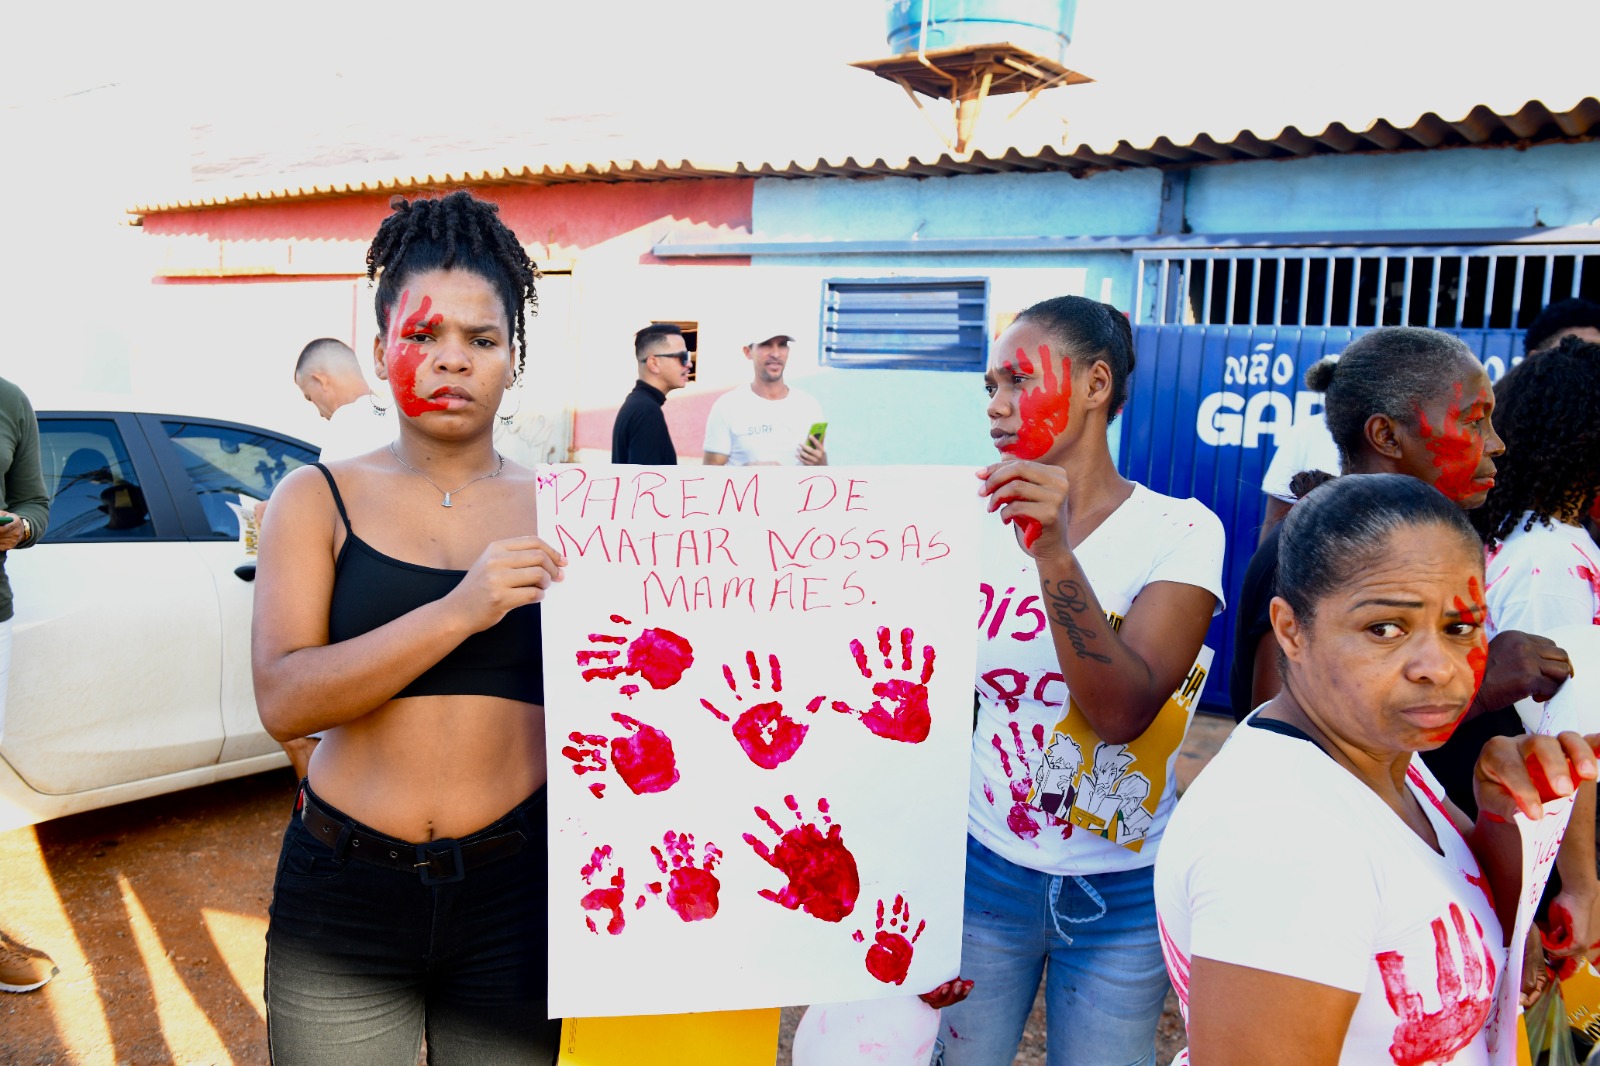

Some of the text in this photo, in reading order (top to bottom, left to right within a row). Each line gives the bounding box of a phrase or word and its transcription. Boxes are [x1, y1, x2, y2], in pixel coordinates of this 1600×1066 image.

[1223, 343, 1294, 385] NÃO
[555, 468, 869, 520] PAREM DE
[555, 524, 950, 571] MATAR NOSSAS
[643, 563, 877, 615] MAMÃES.
[1043, 579, 1112, 664] Rafael
